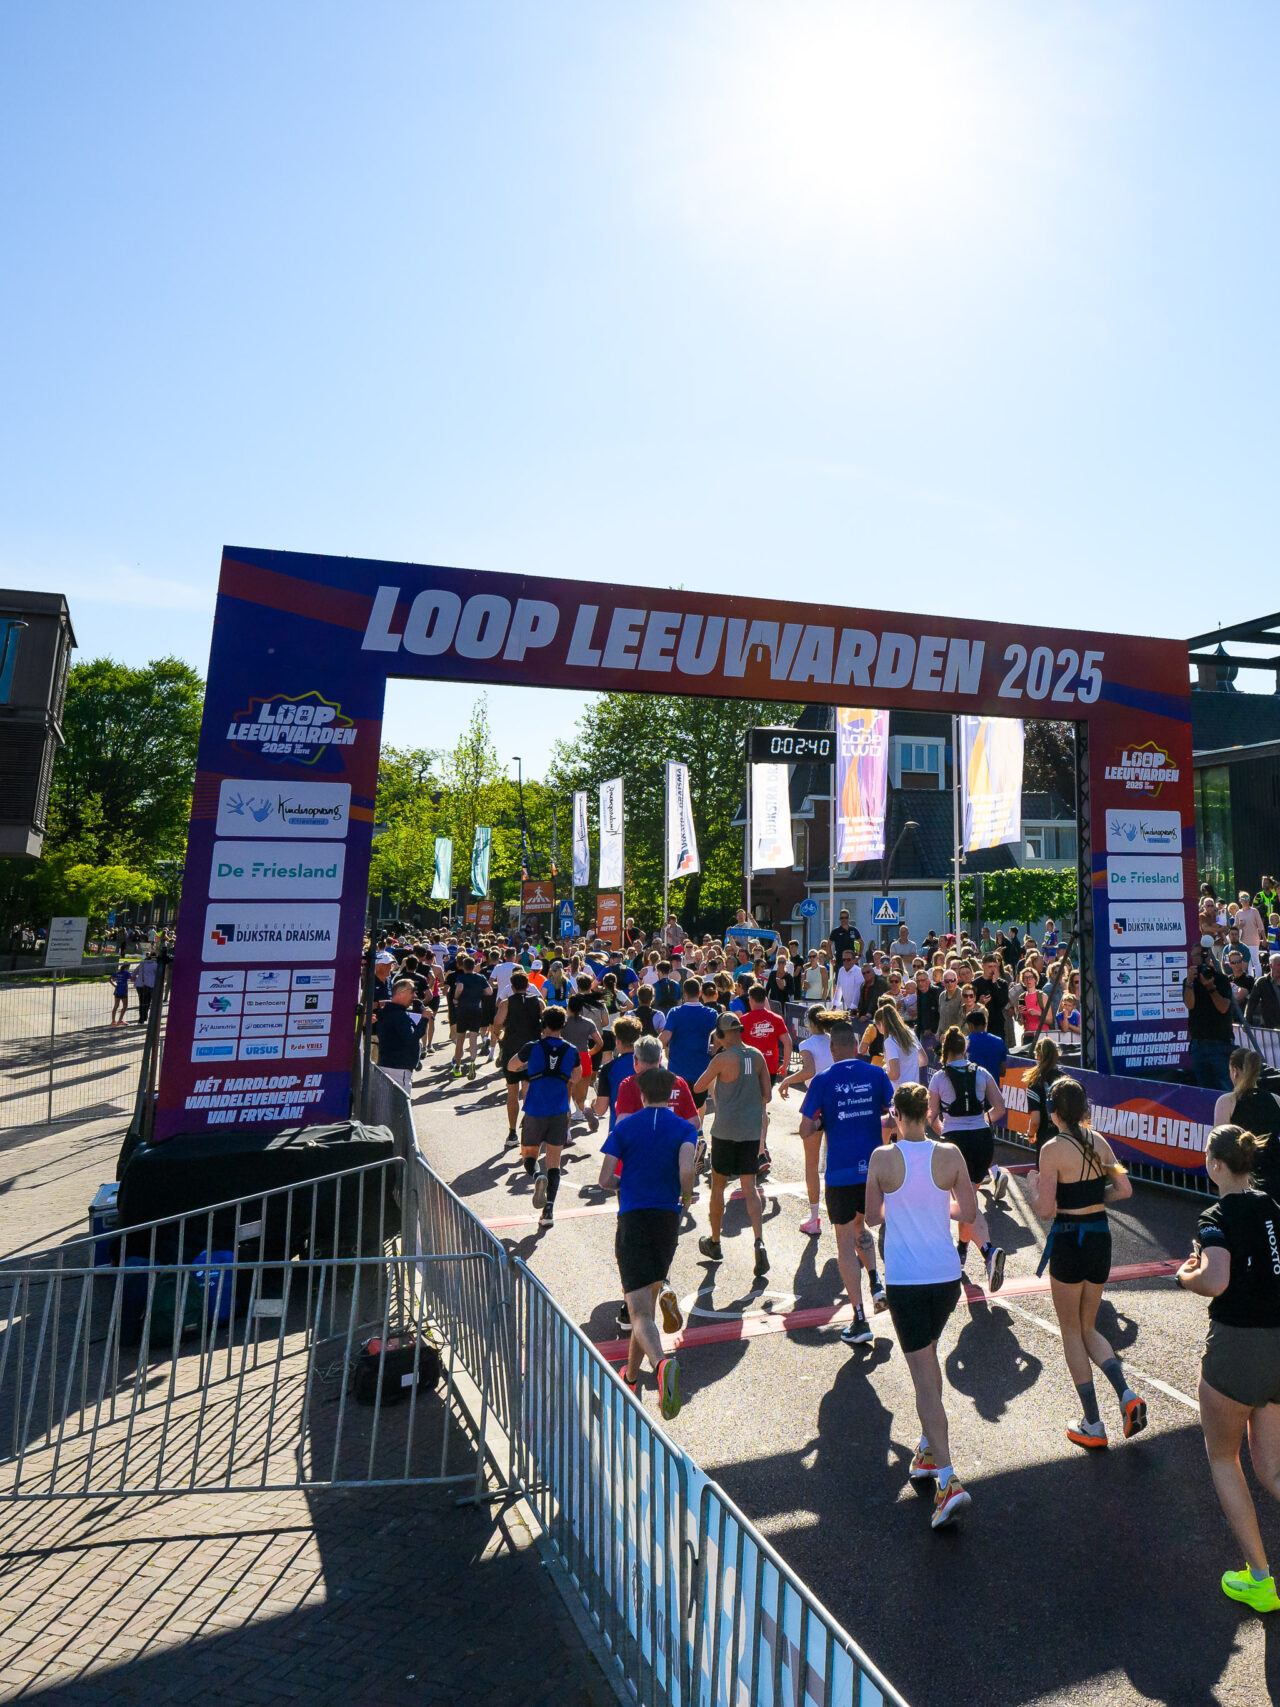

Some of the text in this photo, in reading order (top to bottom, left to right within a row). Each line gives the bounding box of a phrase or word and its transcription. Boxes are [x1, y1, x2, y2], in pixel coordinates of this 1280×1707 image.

[361, 586, 1104, 704] LOOP LEEUWARDEN 2025
[258, 703, 336, 726] LOOP
[226, 723, 357, 745] LEEUWARDEN
[842, 734, 882, 744] LOOP
[261, 743, 292, 754] 2025
[1121, 751, 1166, 768] LOOP
[1104, 766, 1180, 782] LEEUWARDEN
[217, 862, 337, 878] De Friesland
[1111, 871, 1179, 883] De Friesland
[564, 920, 571, 931] P
[1127, 922, 1182, 931] DIJKSTRA DRAISMA
[236, 929, 331, 942] DIJKSTRA DRAISMA
[1115, 1032, 1131, 1044] HÉT
[1177, 1030, 1188, 1041] EN
[245, 1045, 279, 1056] URSUS
[1112, 1042, 1190, 1057] WANDELEVENEMENT
[1125, 1057, 1142, 1068] VAN
[193, 1074, 323, 1093] HÉT HARDLOOP- EN
[184, 1089, 325, 1110] WANDELEVENEMENT
[207, 1103, 305, 1124] VAN FRYSLÂN!
